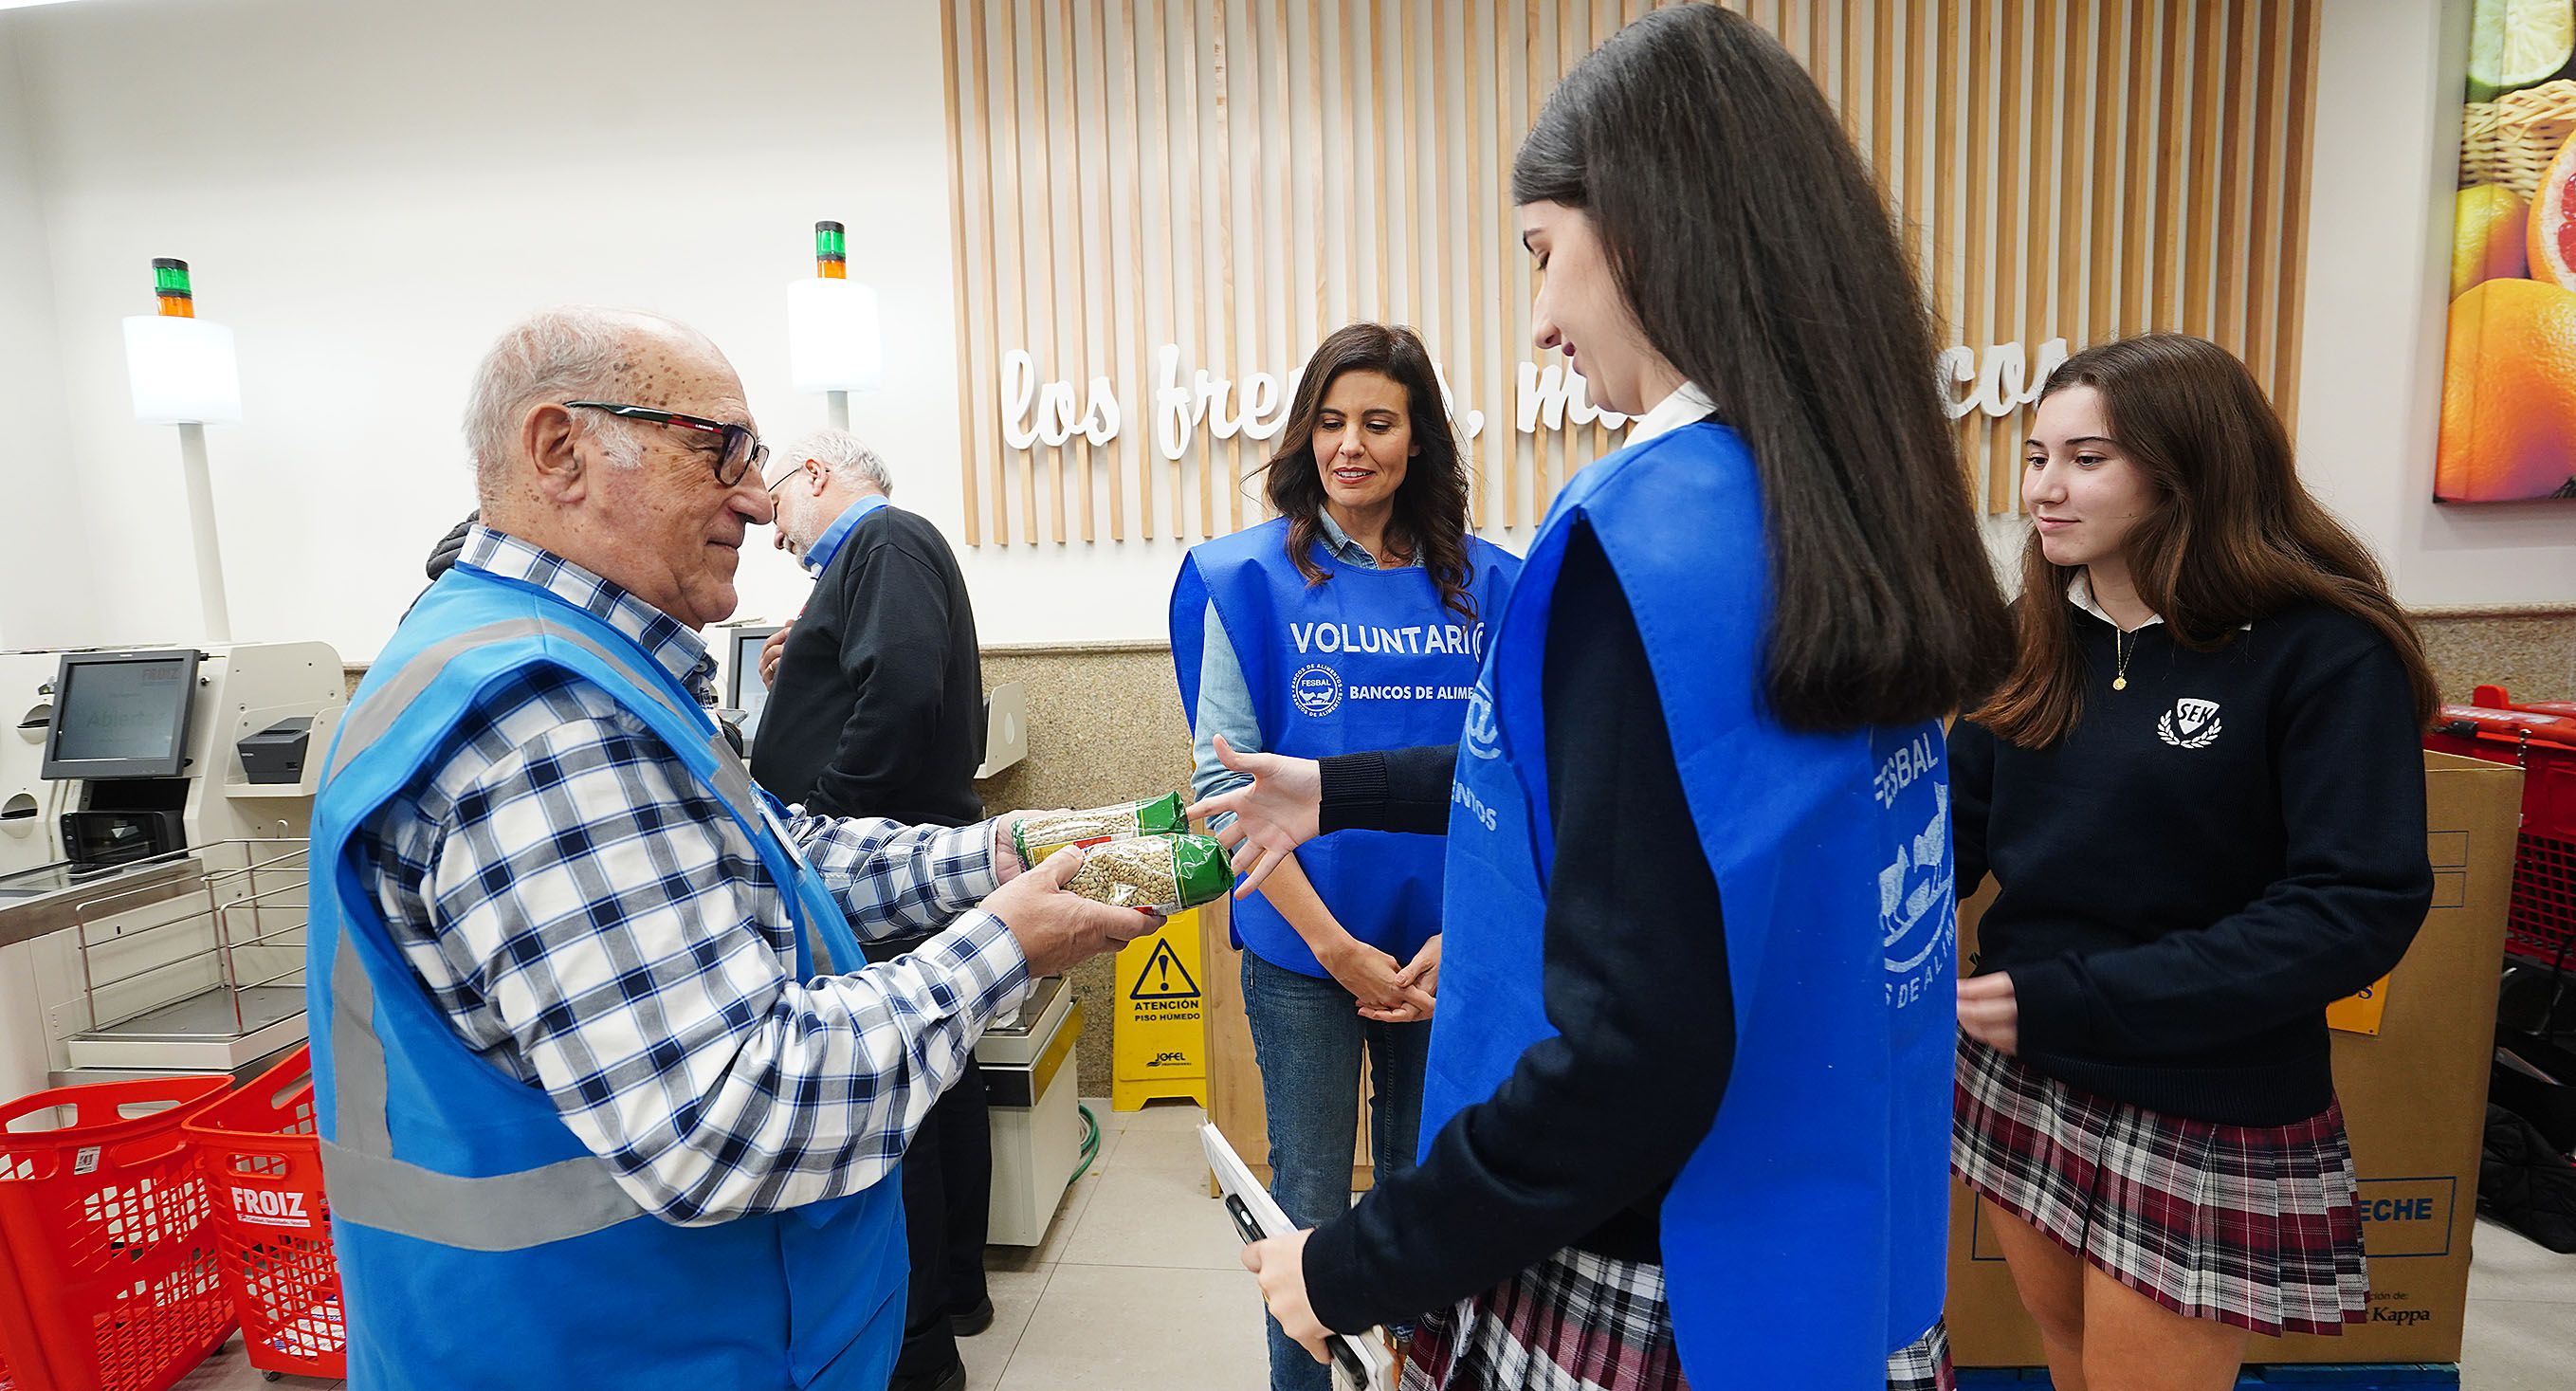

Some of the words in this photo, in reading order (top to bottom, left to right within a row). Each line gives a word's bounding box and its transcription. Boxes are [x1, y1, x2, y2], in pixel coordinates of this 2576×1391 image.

[1001, 349, 1121, 449] los
[1349, 686, 1411, 700] BANCOS
[1416, 686, 1434, 700] DE
[2178, 703, 2214, 723] SEK
[1898, 977, 1920, 1010] DE
[1134, 999, 1199, 1011] ATENCIÓN
[1160, 1013, 1200, 1021] HÚMEDO
[1155, 1052, 1186, 1062] JOFEL
[230, 1187, 307, 1217] FROIZ
[2372, 1307, 2430, 1326] Kappa
